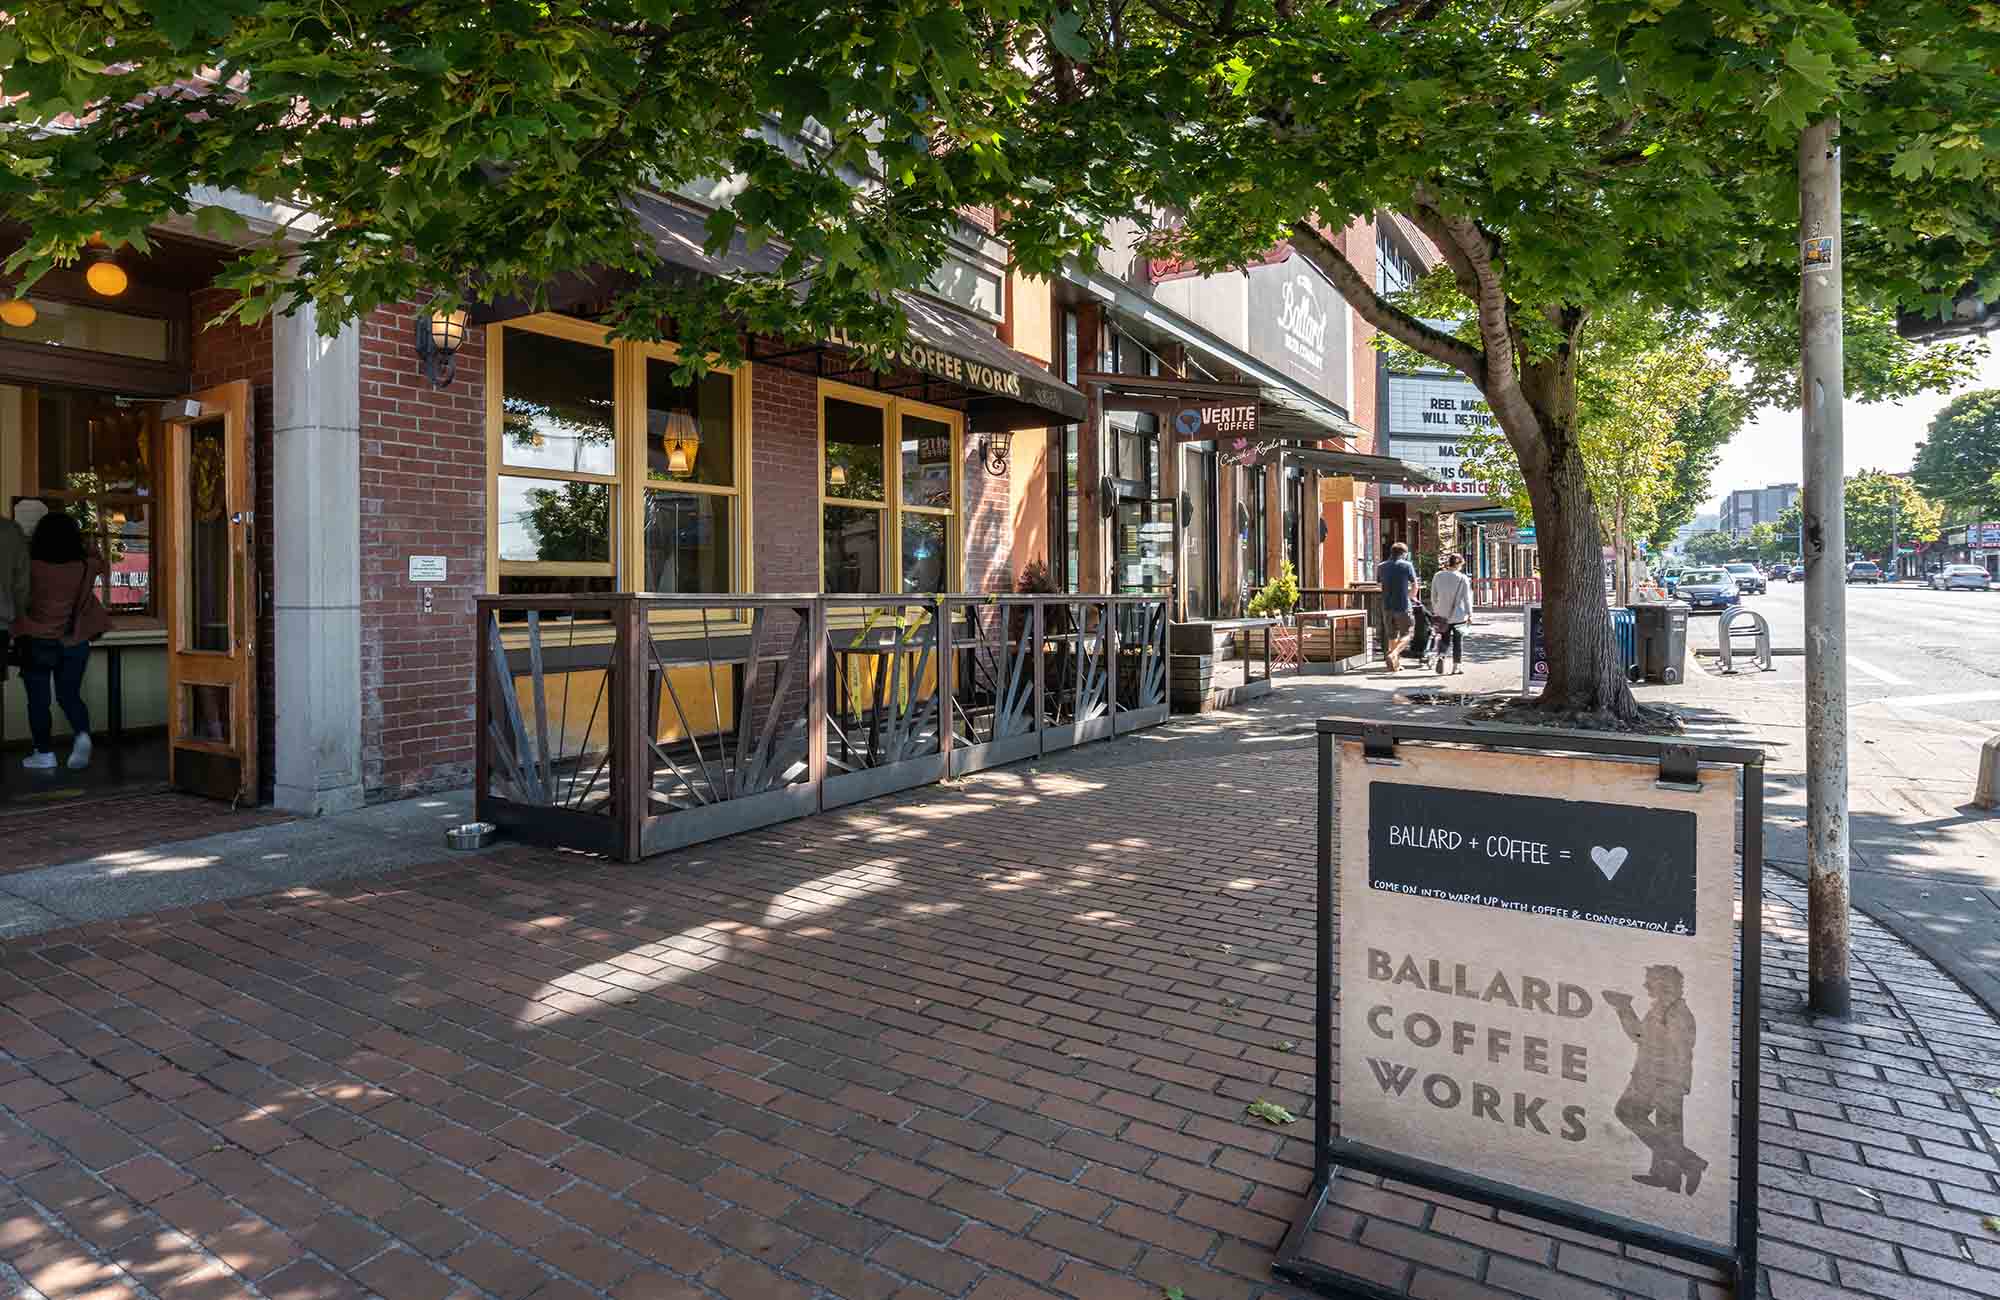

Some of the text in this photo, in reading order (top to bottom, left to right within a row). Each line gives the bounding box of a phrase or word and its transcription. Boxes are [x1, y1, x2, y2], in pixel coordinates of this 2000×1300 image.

[900, 342, 962, 380] COFFEE
[965, 360, 1021, 397] WORKS
[1201, 406, 1255, 424] VERITE
[1422, 411, 1449, 424] WILL
[1430, 398, 1457, 410] REEL
[1217, 421, 1255, 431] COFFEE
[1389, 825, 1462, 850] BALLARD
[1486, 835, 1550, 865] COFFEE
[1374, 879, 1400, 893] COME
[1402, 884, 1417, 895] ON
[1448, 892, 1481, 905] WARM
[1483, 895, 1499, 907] UP
[1500, 900, 1528, 912] WITH
[1531, 905, 1569, 918] COFFEE
[1367, 947, 1594, 1019] BALLARD
[1367, 1004, 1588, 1083] COFFEE
[1366, 1057, 1588, 1143] WORKS
